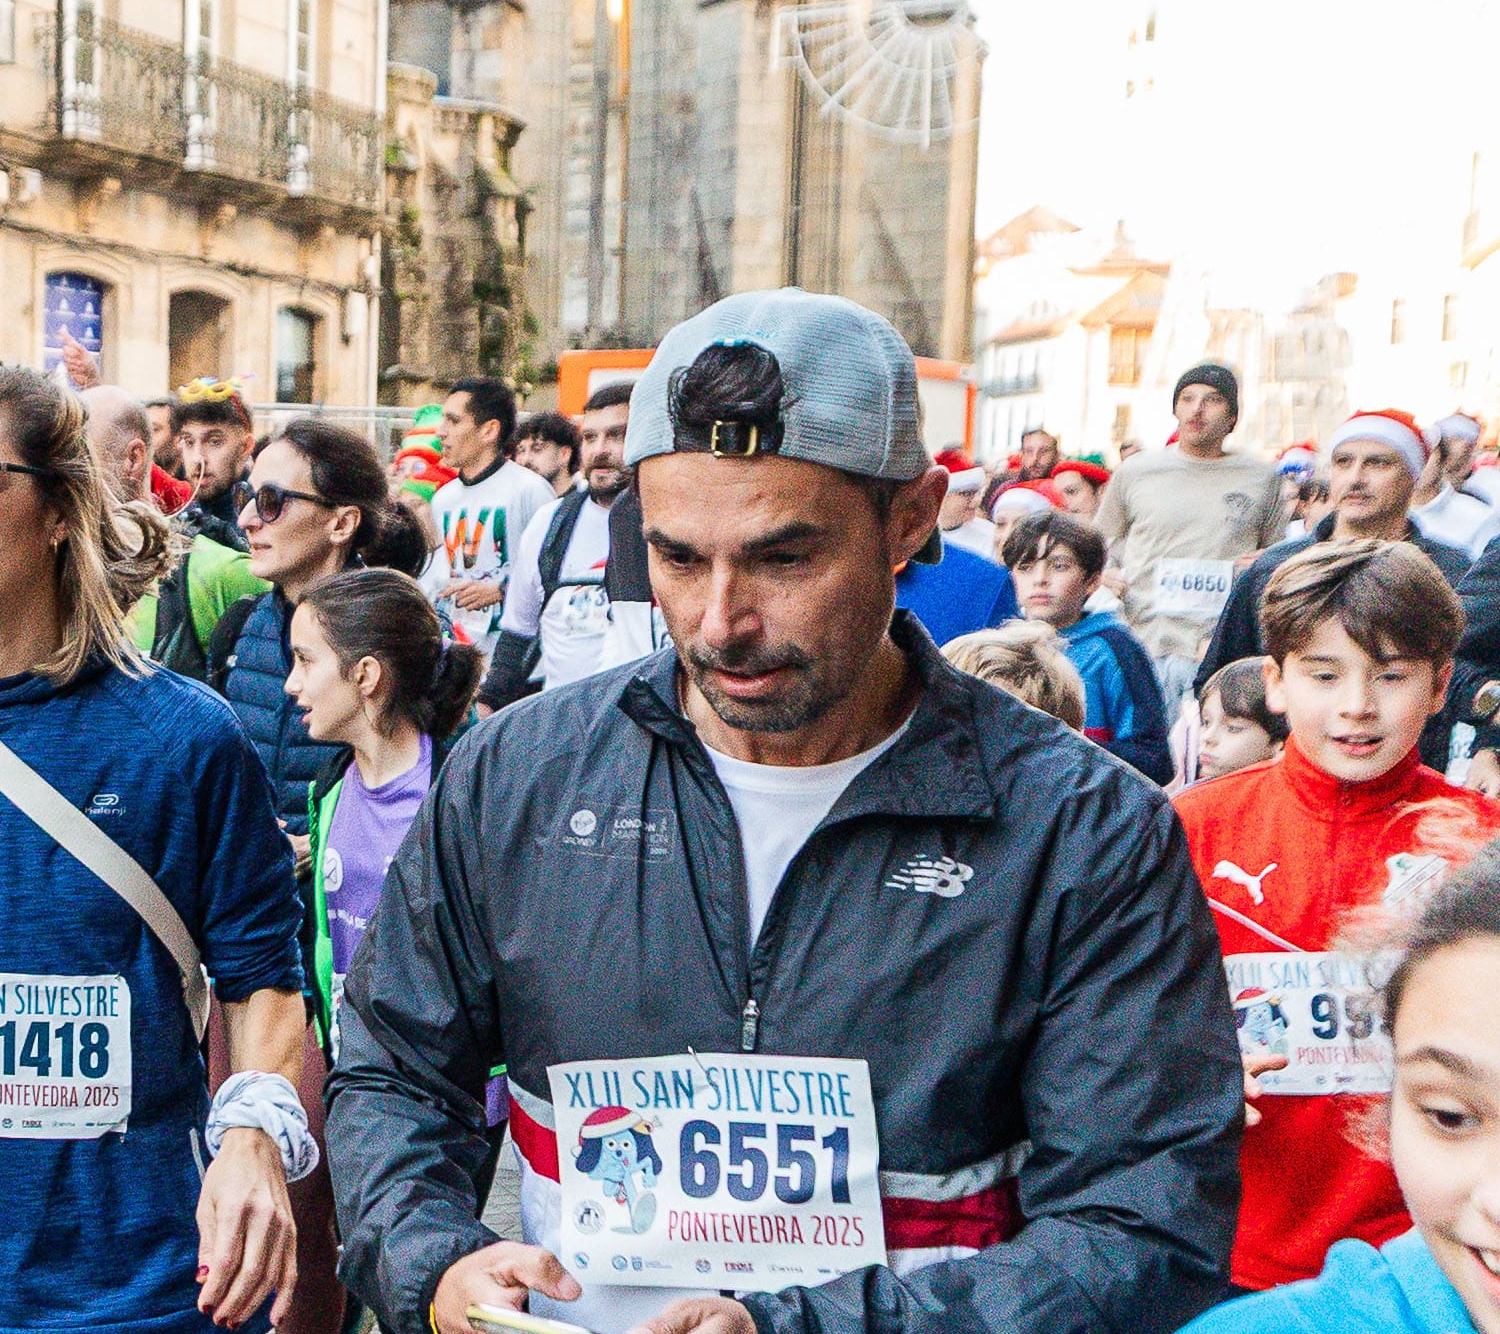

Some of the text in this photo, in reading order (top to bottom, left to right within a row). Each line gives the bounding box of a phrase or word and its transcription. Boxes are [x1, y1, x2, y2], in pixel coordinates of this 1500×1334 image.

[1270, 961, 1311, 989] SAN
[14, 983, 119, 1017] SILVESTRE
[84, 1085, 119, 1107] 2025
[564, 1067, 855, 1117] XLII SAN SILVESTRE
[679, 1119, 852, 1204] 6551
[668, 1210, 865, 1246] PONTEVEDRA 2025
